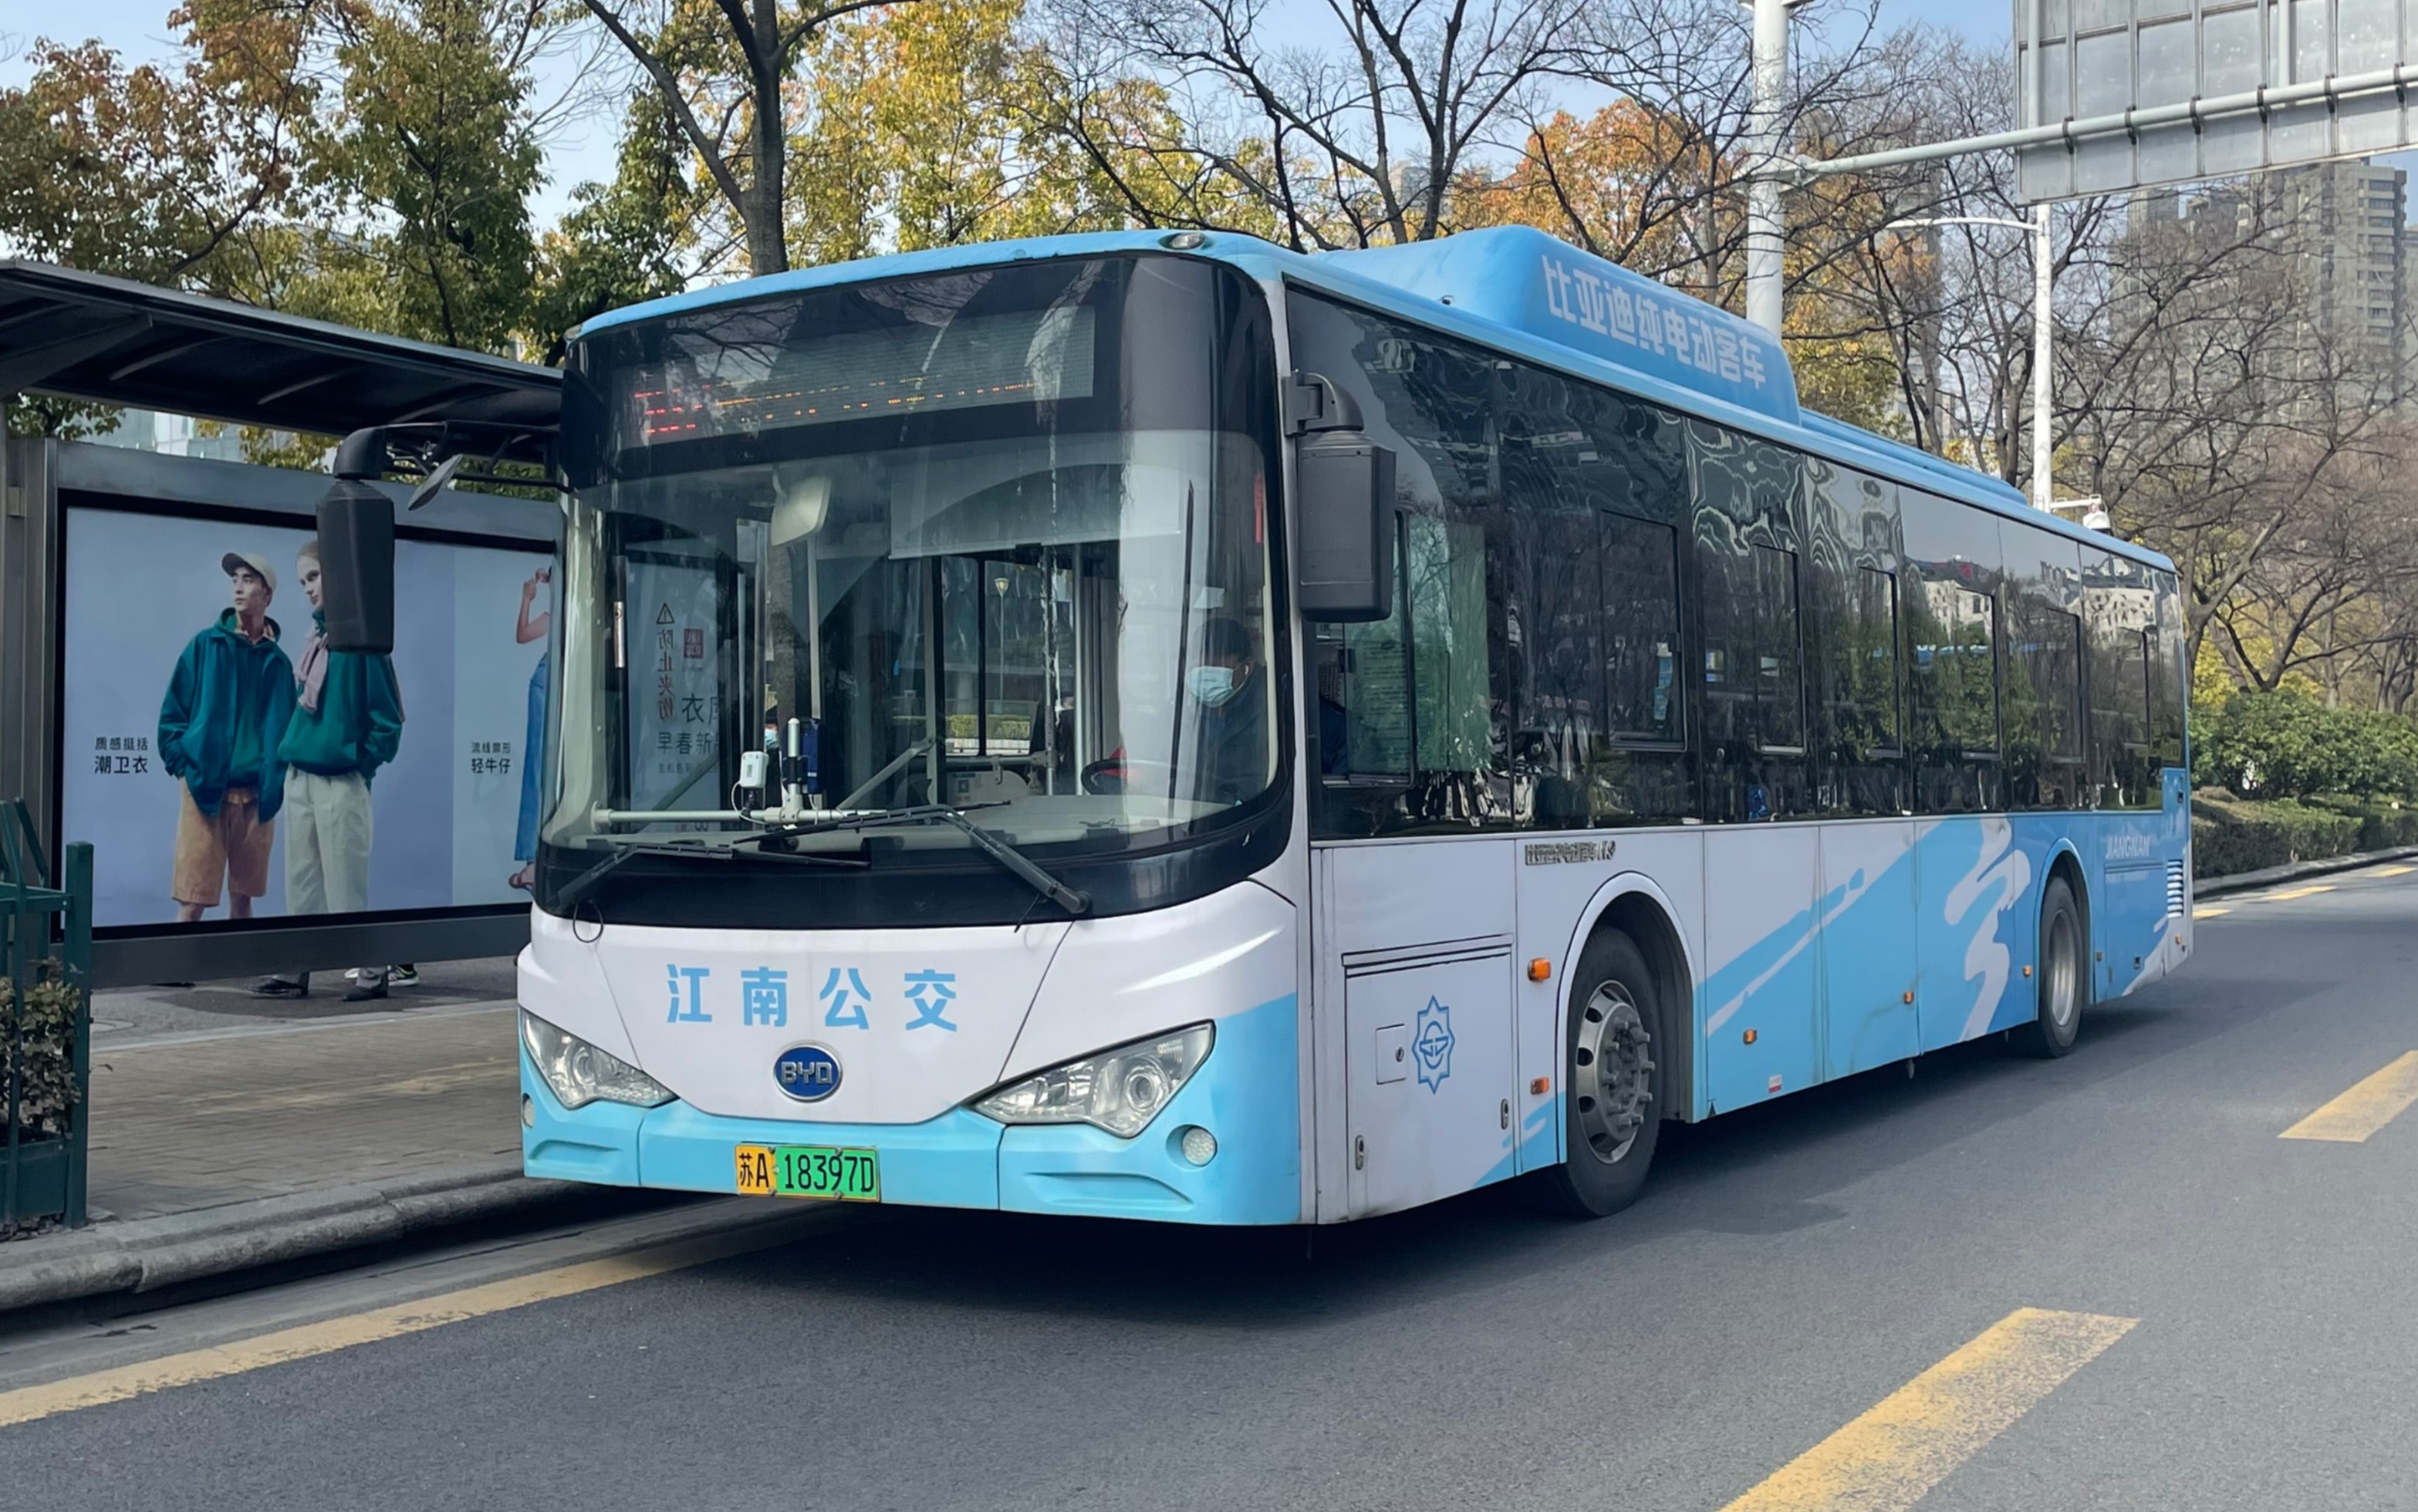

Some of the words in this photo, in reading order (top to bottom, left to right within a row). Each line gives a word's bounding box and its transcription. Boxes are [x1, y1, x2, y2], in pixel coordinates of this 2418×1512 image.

[1542, 255, 1766, 390] 比亚迪纯电动客车
[94, 754, 148, 774] 潮卫衣
[471, 758, 511, 775] 轻牛仔
[667, 964, 957, 1032] 江南公交
[780, 1061, 832, 1085] BYD
[739, 1152, 770, 1188] 苏A
[784, 1153, 874, 1193] 18397D
